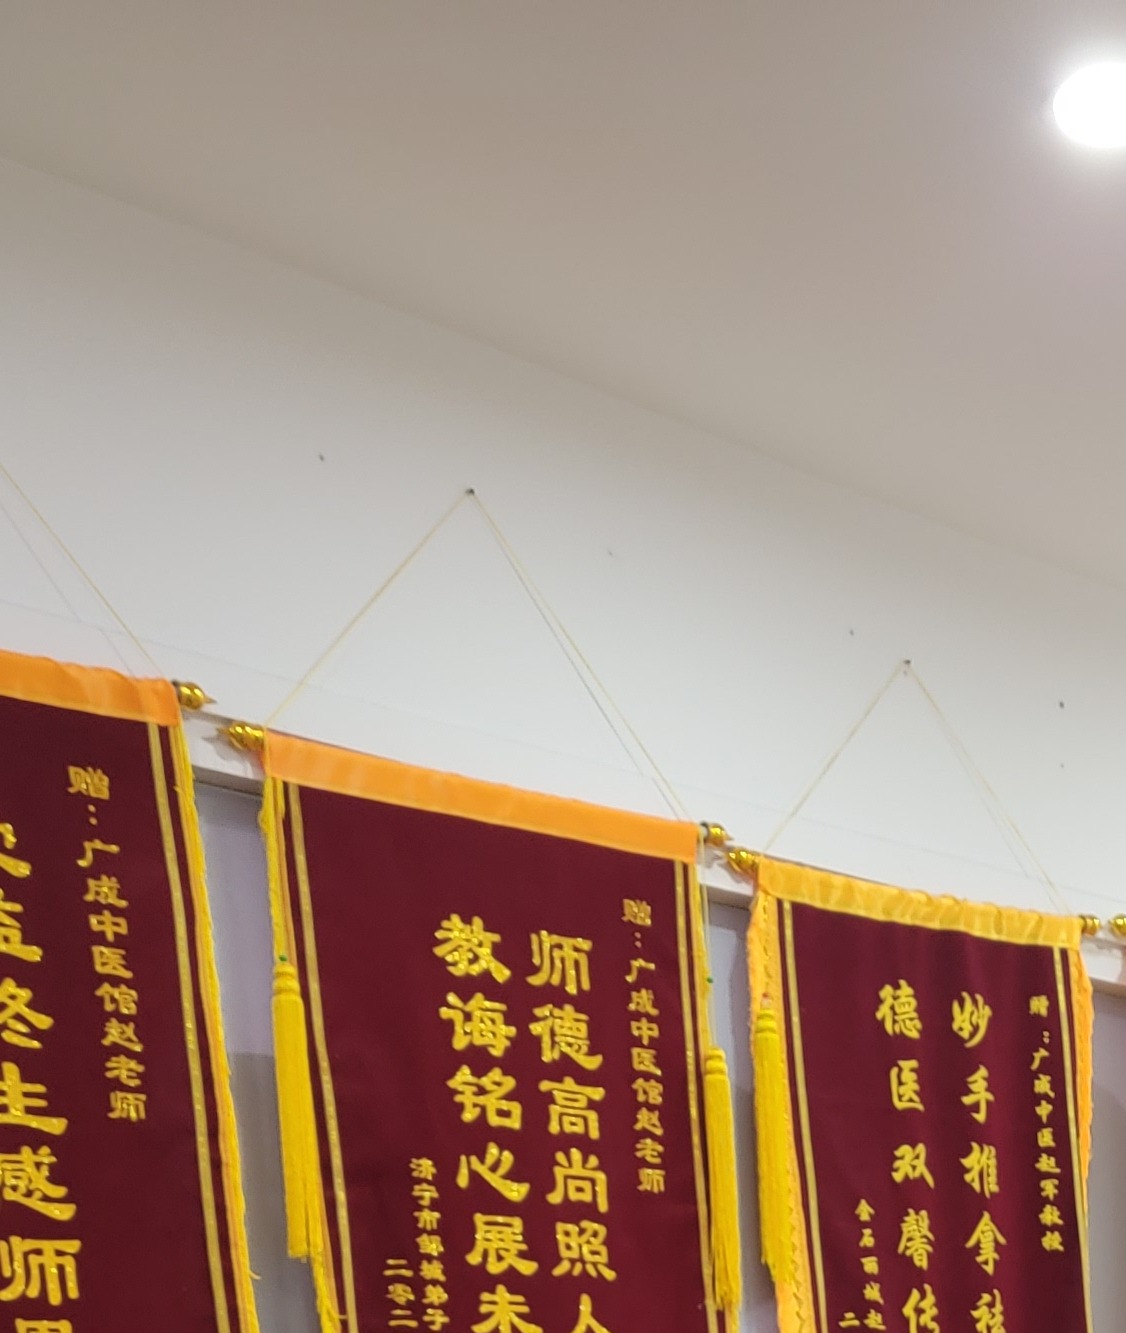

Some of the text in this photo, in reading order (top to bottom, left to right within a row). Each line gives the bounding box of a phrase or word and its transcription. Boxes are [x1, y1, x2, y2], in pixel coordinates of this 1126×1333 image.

[67, 765, 147, 1121] 赠：广成中医馆赵老师
[621, 898, 667, 1194] 赠：广成中医馆赵老师
